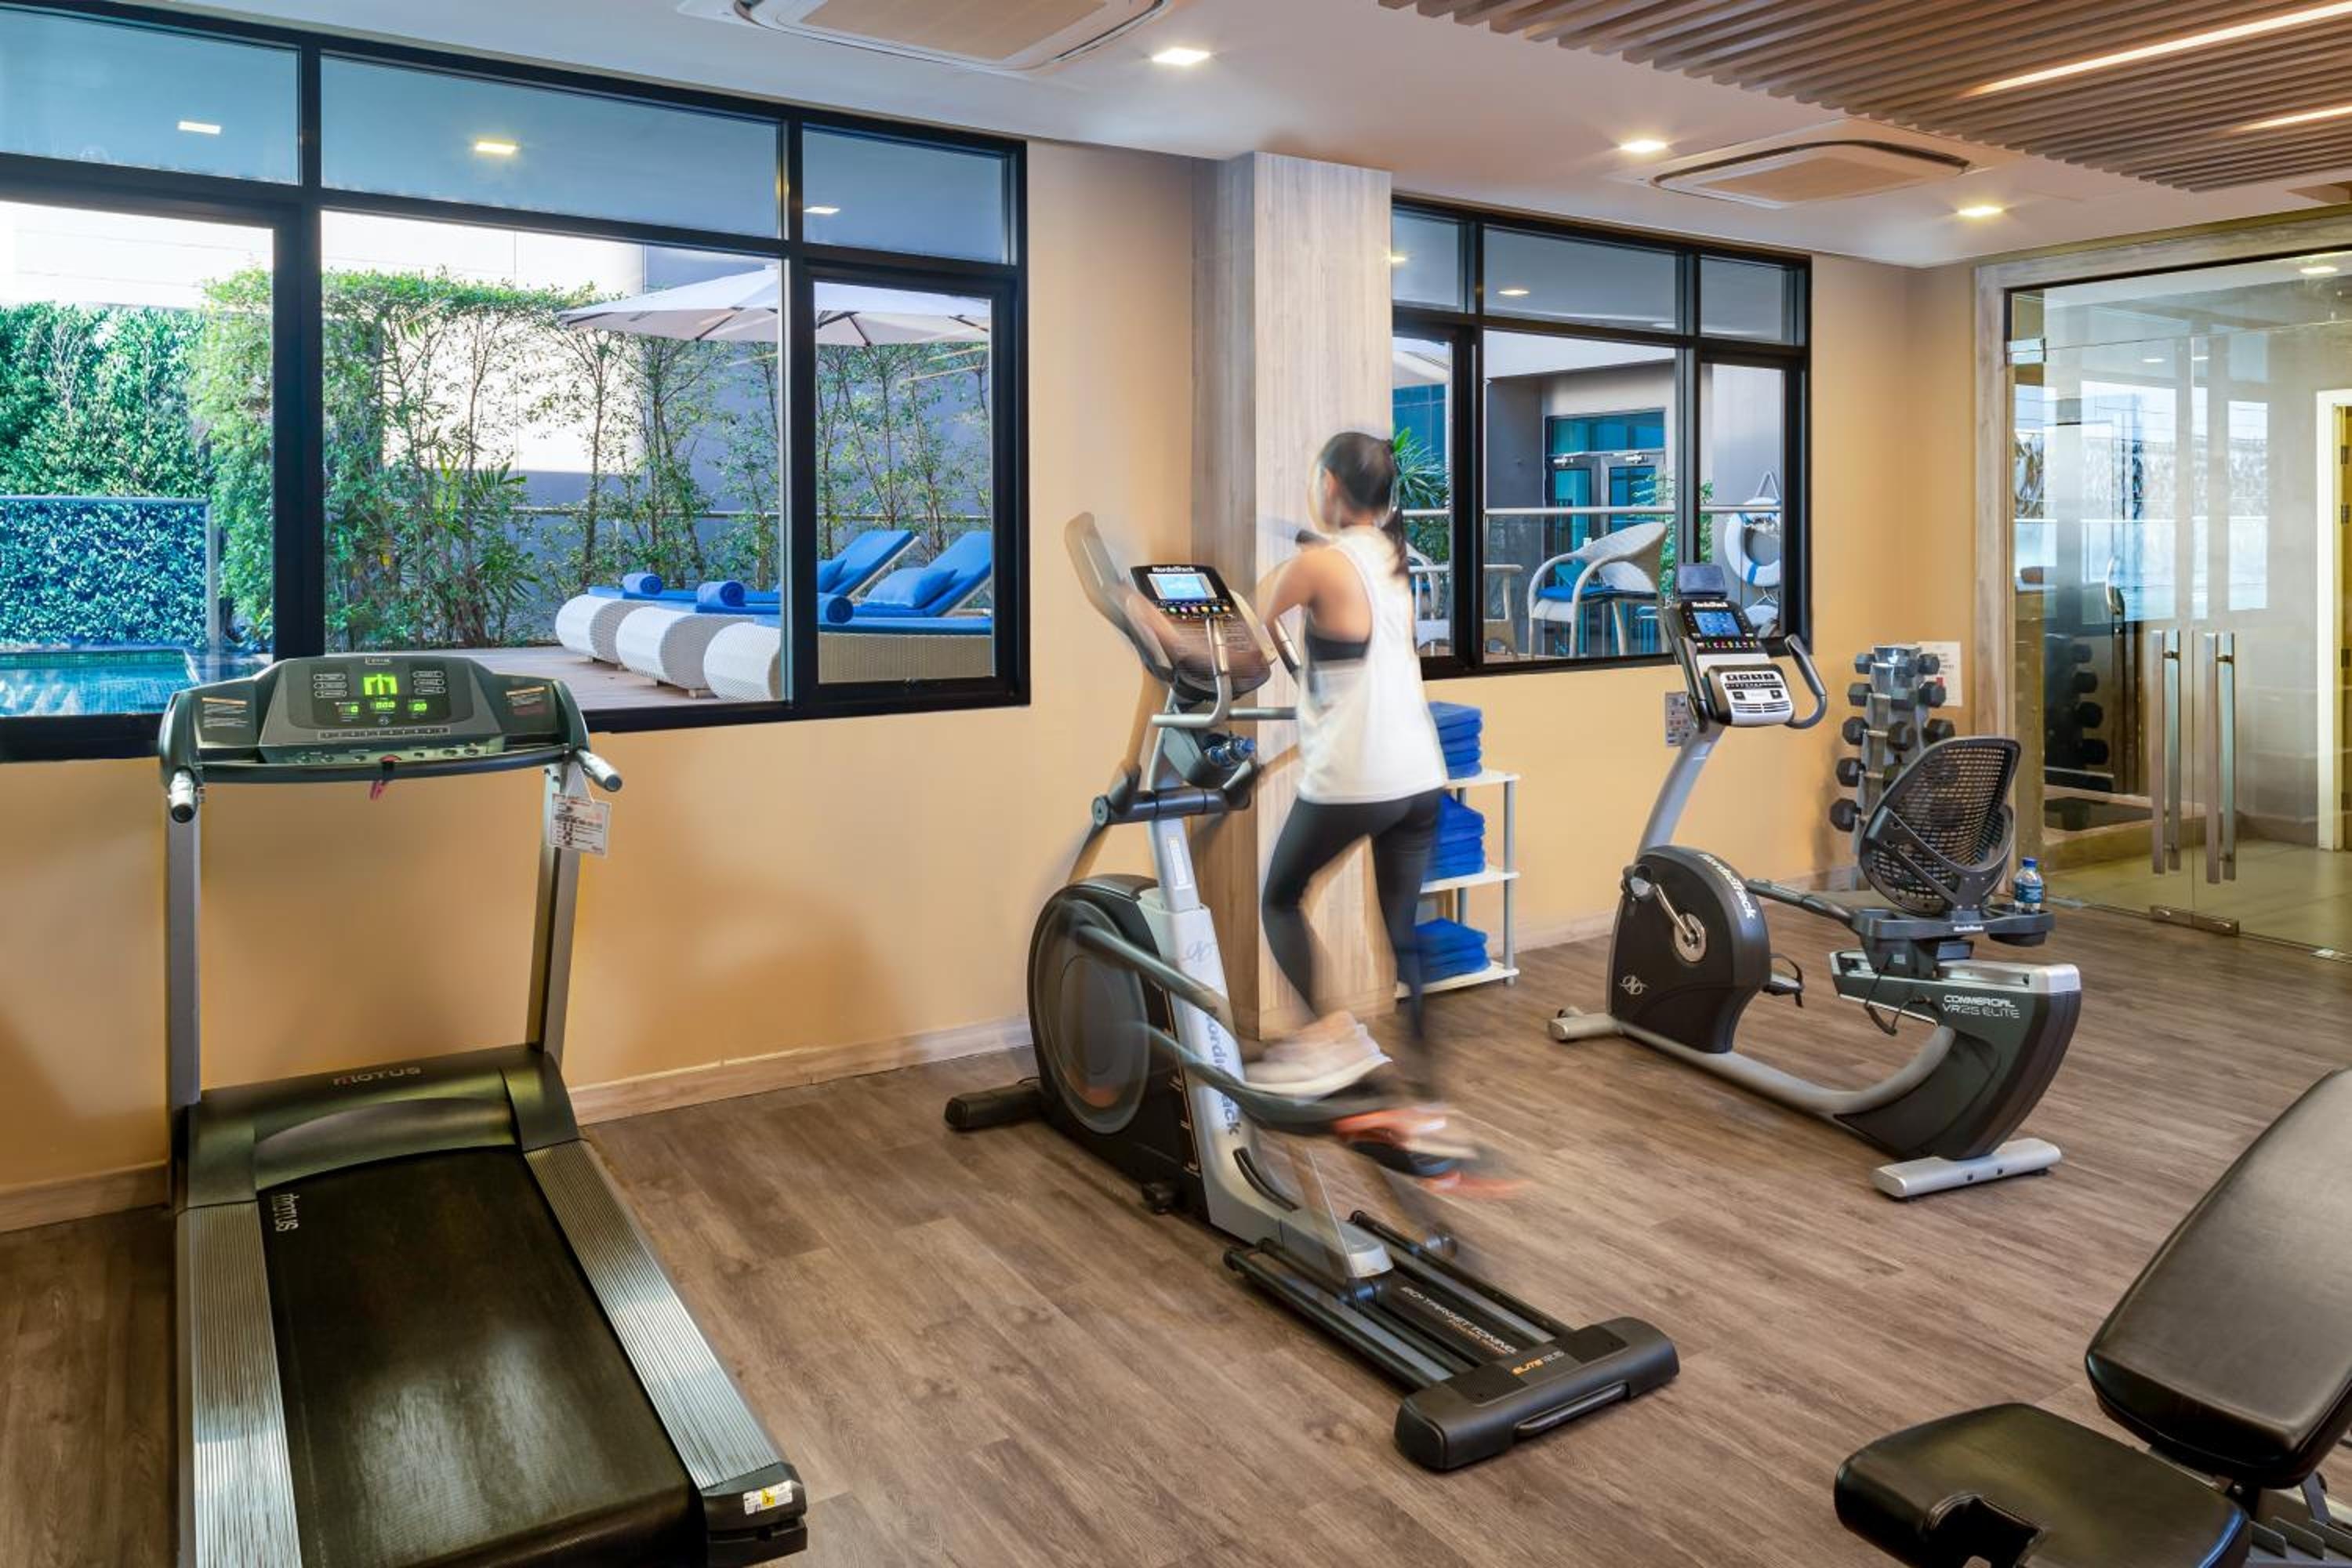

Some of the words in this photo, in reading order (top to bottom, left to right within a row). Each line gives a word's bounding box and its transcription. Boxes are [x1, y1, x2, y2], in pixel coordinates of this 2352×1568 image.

[1697, 853, 1757, 919] NordicTrack
[1944, 994, 2016, 1008] COMMERCIAL
[1942, 1004, 1981, 1015] VR25
[1981, 1005, 2020, 1018] ELITE
